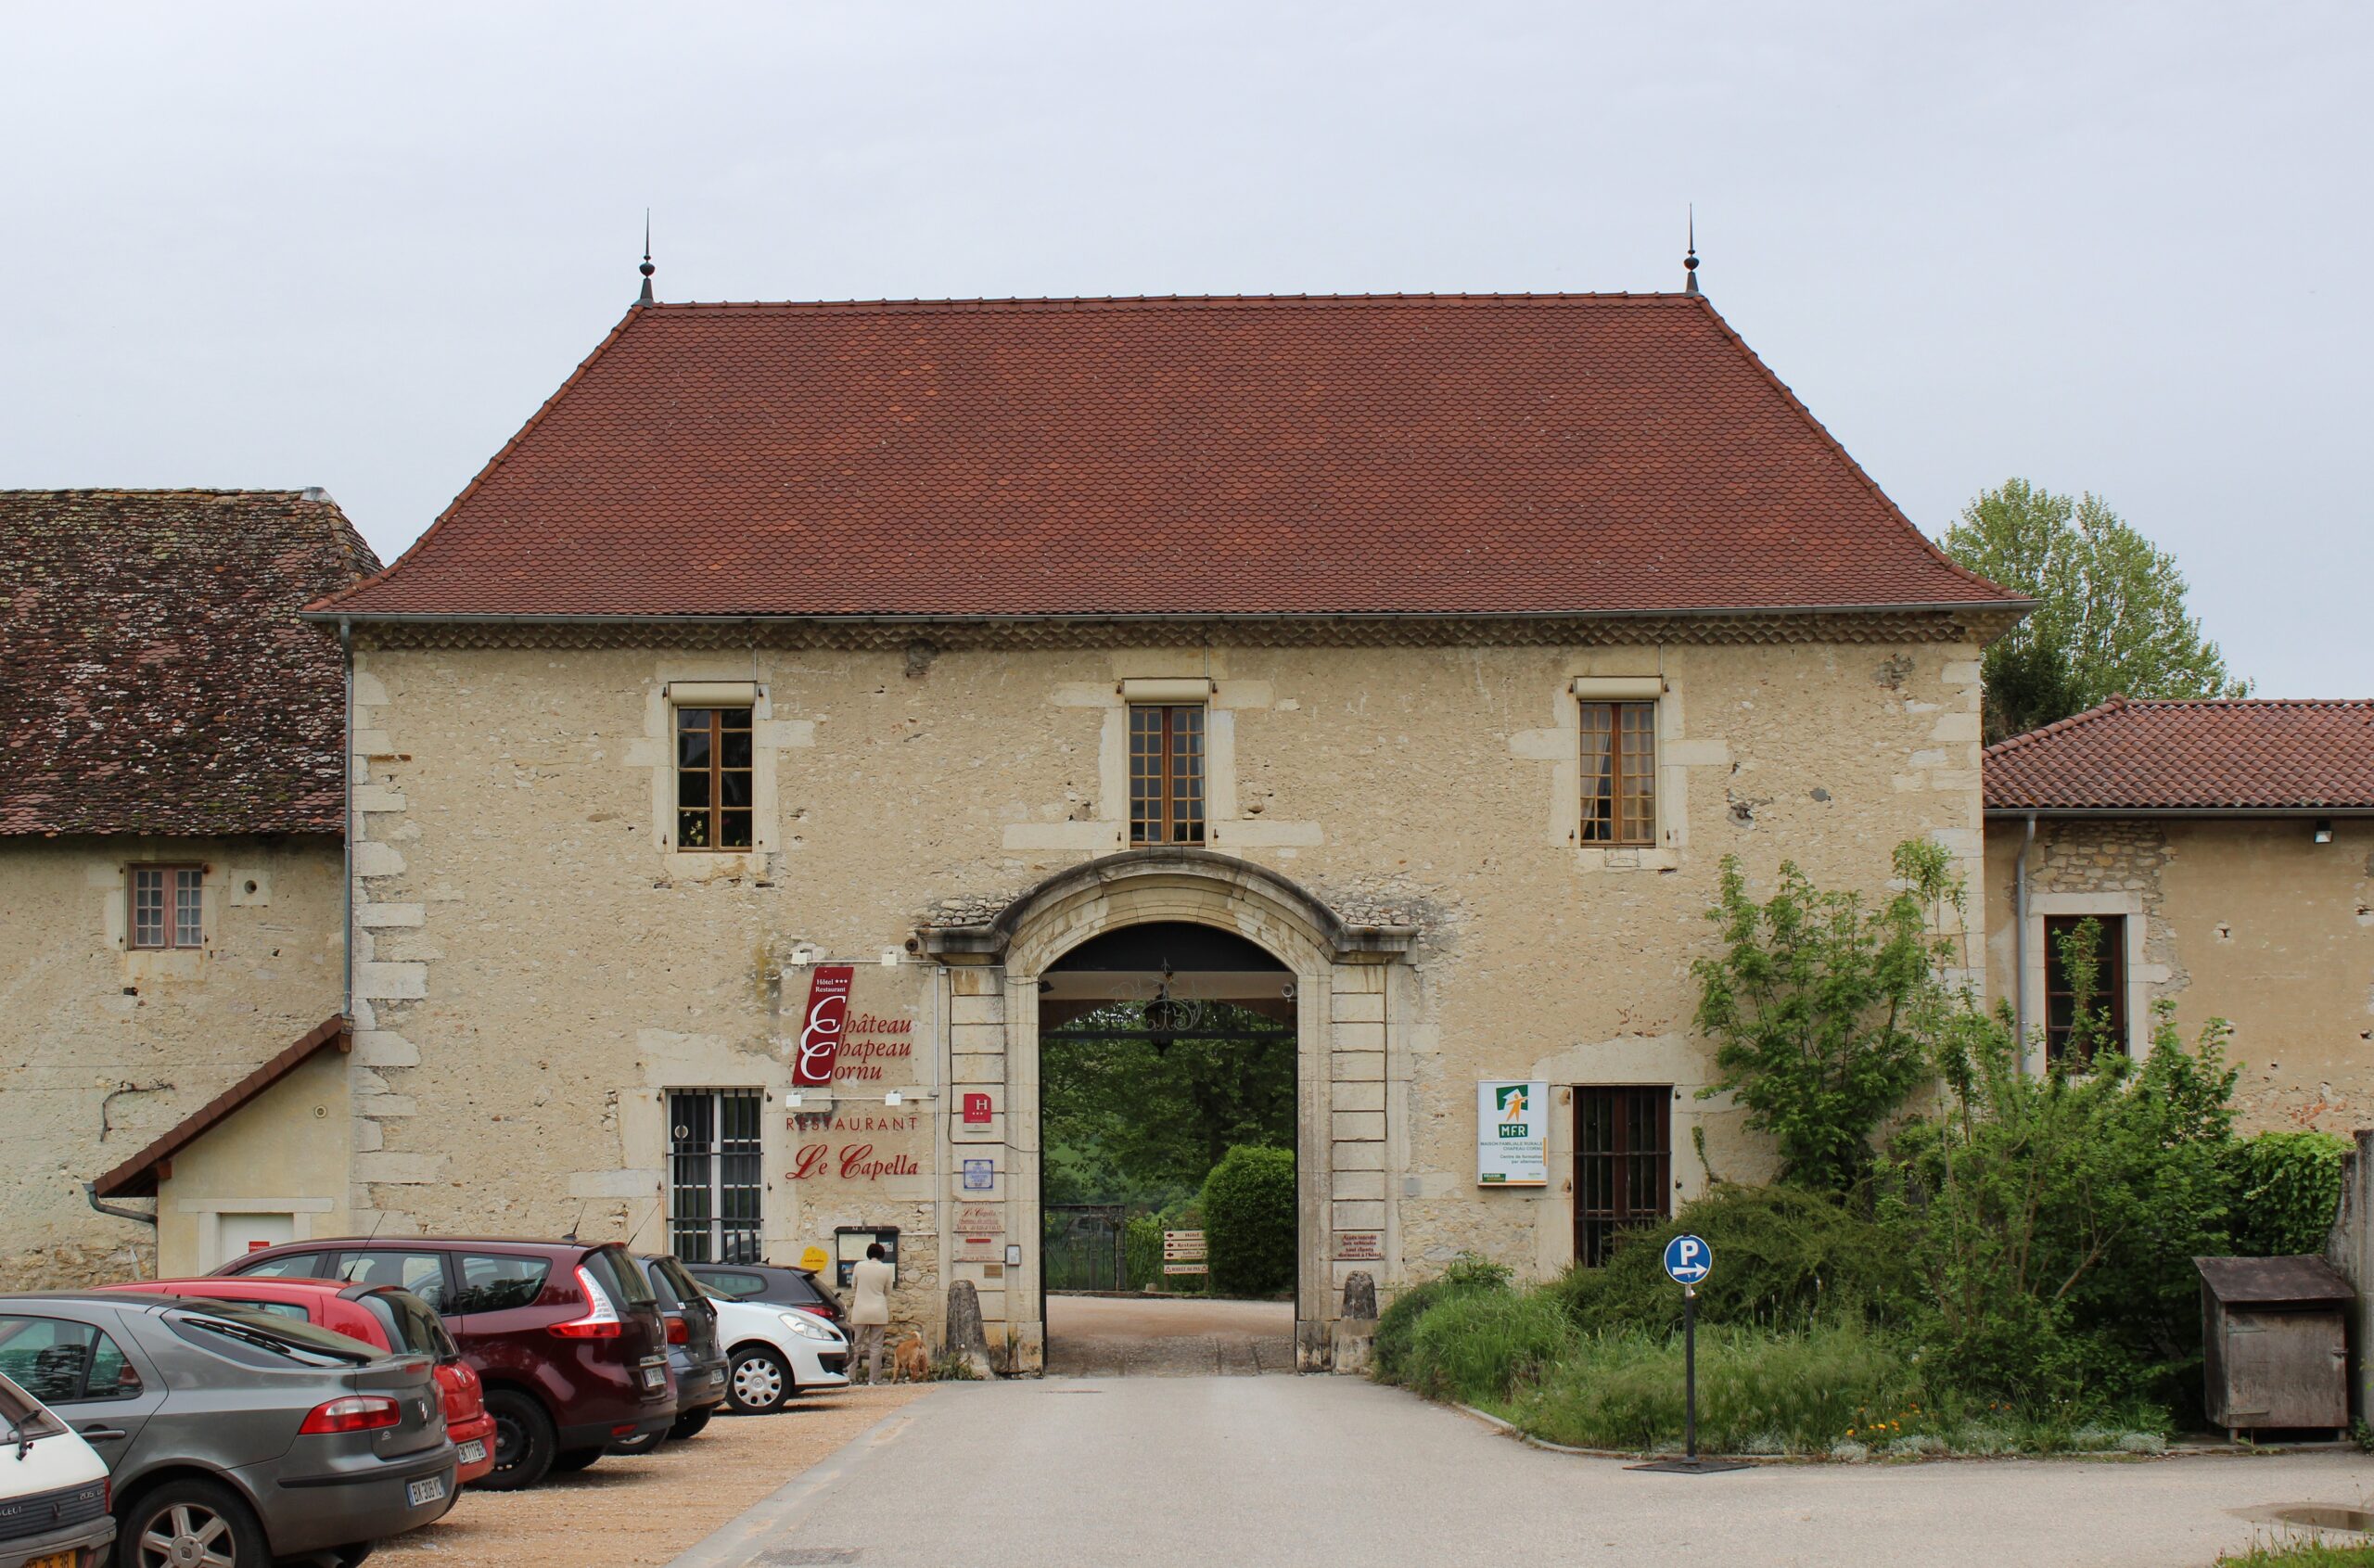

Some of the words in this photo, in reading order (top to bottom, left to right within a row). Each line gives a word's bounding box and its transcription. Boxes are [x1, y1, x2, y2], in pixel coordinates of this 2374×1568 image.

[810, 995, 913, 1034] Château
[800, 1018, 913, 1064] Chapeau
[800, 1041, 883, 1080] Cornu
[976, 1099, 988, 1110] H
[786, 1116, 918, 1130] RESTAURANT
[1501, 1125, 1525, 1137] MFR
[785, 1143, 828, 1179] Le
[839, 1143, 918, 1180] Capella
[1679, 1240, 1699, 1266] P
